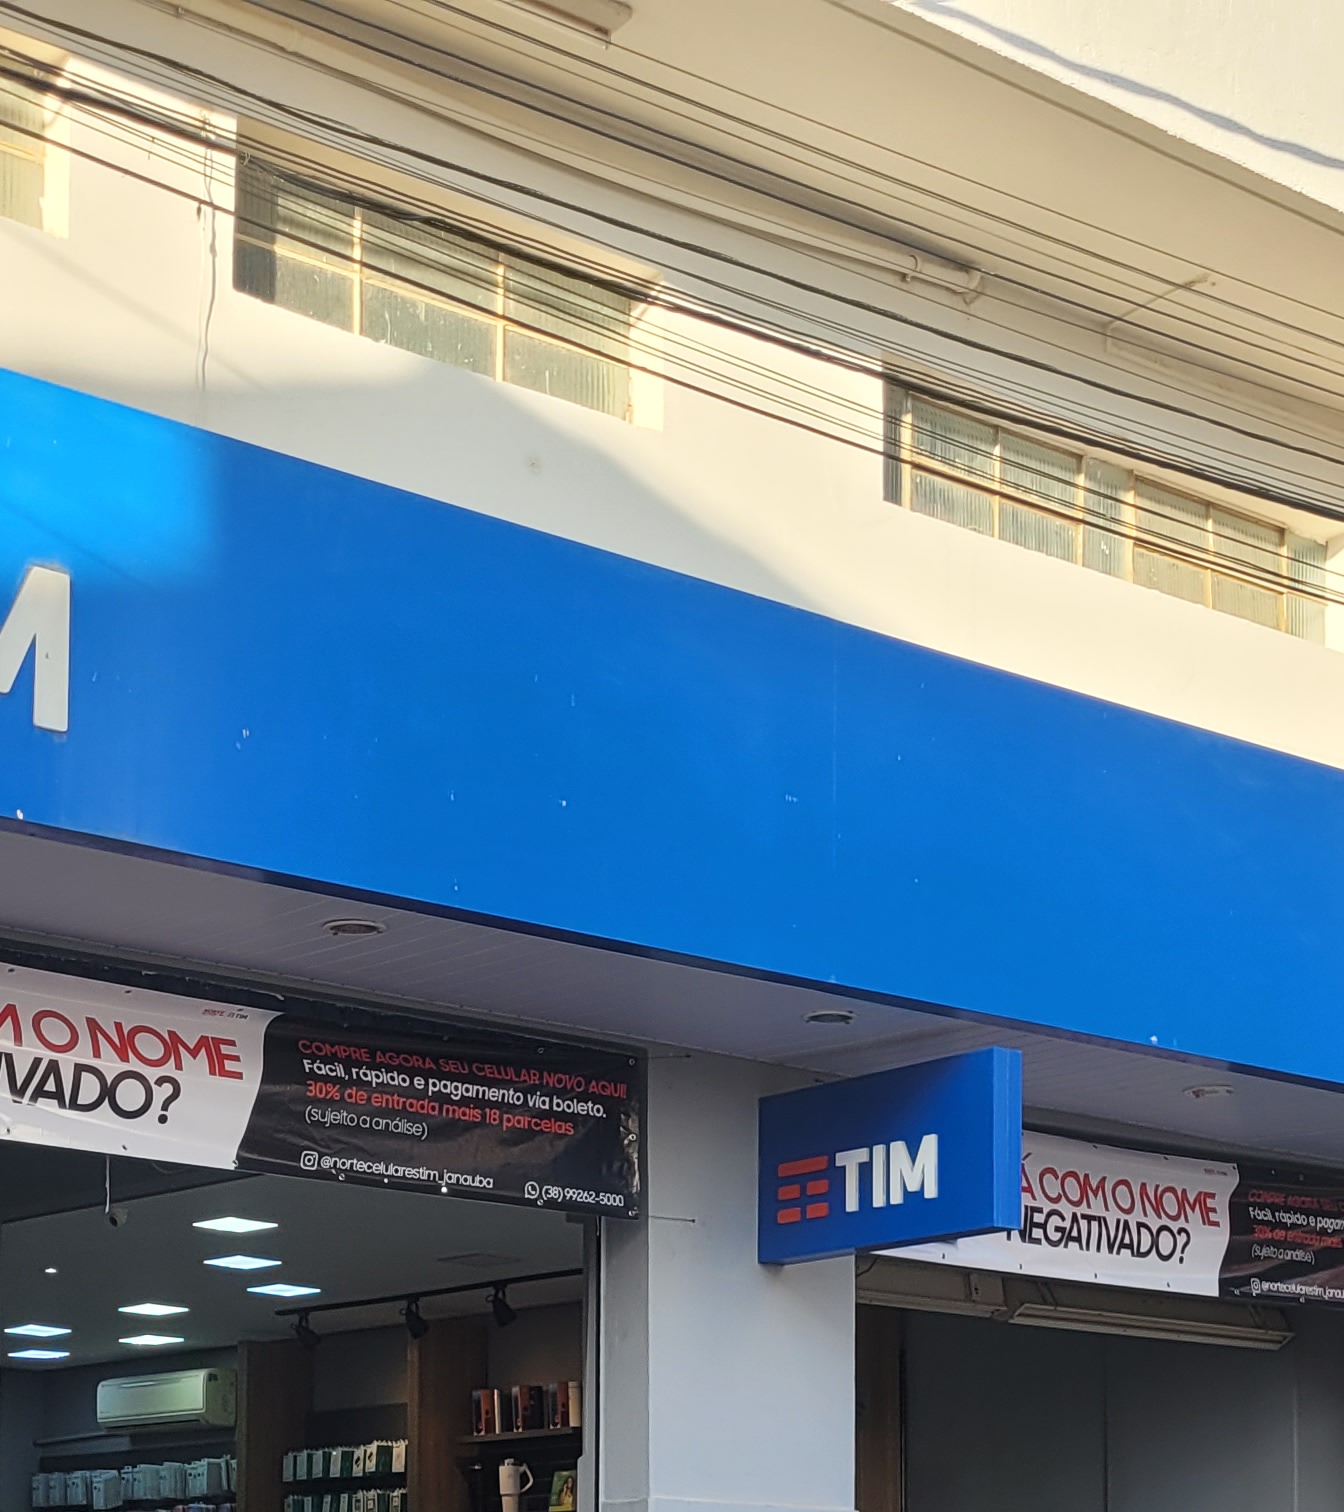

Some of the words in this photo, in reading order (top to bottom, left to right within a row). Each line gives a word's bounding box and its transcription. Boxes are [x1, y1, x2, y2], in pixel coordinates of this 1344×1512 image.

[32, 1009, 79, 1054] O
[85, 1016, 244, 1081] NOME
[298, 1040, 372, 1062] COMPRE
[376, 1051, 436, 1069] AGORA
[440, 1058, 469, 1074] SEU
[472, 1063, 540, 1085] CELULAR
[543, 1071, 586, 1092] NOVO
[303, 1059, 349, 1081] Fácil,
[352, 1066, 410, 1087] rápido
[413, 1076, 425, 1089] e
[428, 1077, 524, 1105] pagamento
[527, 1091, 550, 1110] via
[552, 1096, 607, 1118] boleto.
[306, 1081, 341, 1100] 30%
[344, 1086, 368, 1105] de
[371, 1093, 439, 1116] entrada
[442, 1104, 482, 1122] mais
[485, 1107, 500, 1125] 18
[503, 1113, 574, 1135] parcelas
[305, 1105, 357, 1127] (sujeito
[359, 1116, 370, 1129] a
[372, 1115, 429, 1140] análise)
[541, 1184, 563, 1203] (38)
[564, 1187, 625, 1207] 99262-5000
[835, 1133, 938, 1213] TIM
[1038, 1166, 1110, 1212] COM
[1111, 1178, 1136, 1215] O
[1140, 1182, 1221, 1228] NOME
[1006, 1204, 1191, 1264] NEGATIVADO?
[1308, 1215, 1316, 1226] e
